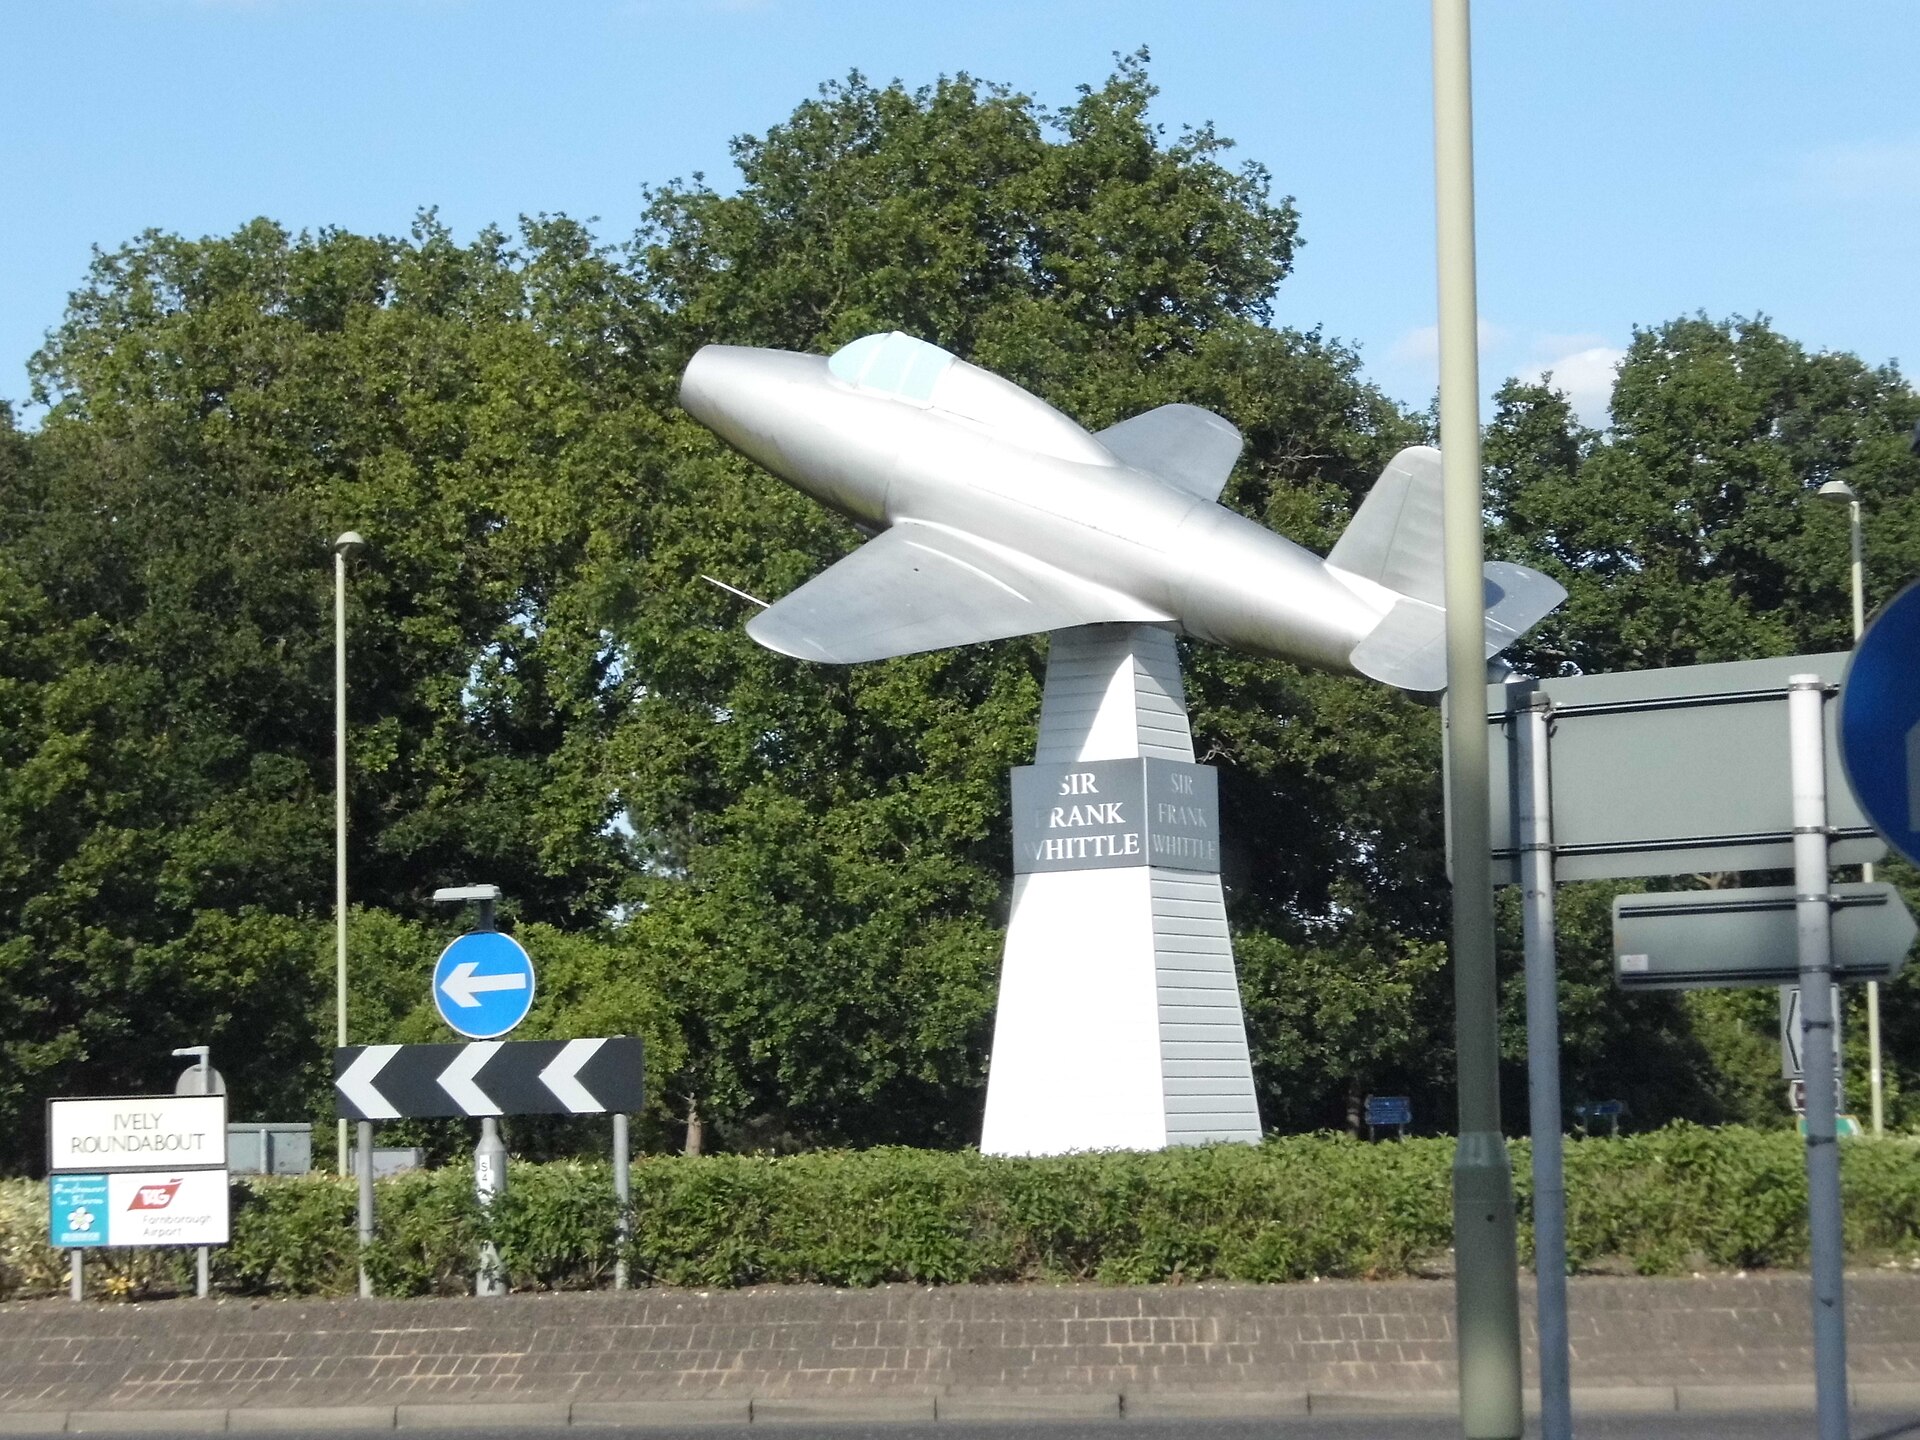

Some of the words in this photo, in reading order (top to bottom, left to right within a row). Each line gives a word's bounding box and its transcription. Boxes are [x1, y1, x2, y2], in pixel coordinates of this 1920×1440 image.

[1058, 772, 1099, 796] SIR
[1171, 773, 1193, 795] SIR
[1158, 803, 1207, 828] FRANK
[1153, 834, 1217, 860] WHITTLE
[113, 1112, 163, 1131] IVELY
[71, 1133, 206, 1154] ROUNDABOUT
[143, 1228, 182, 1238] Airport
